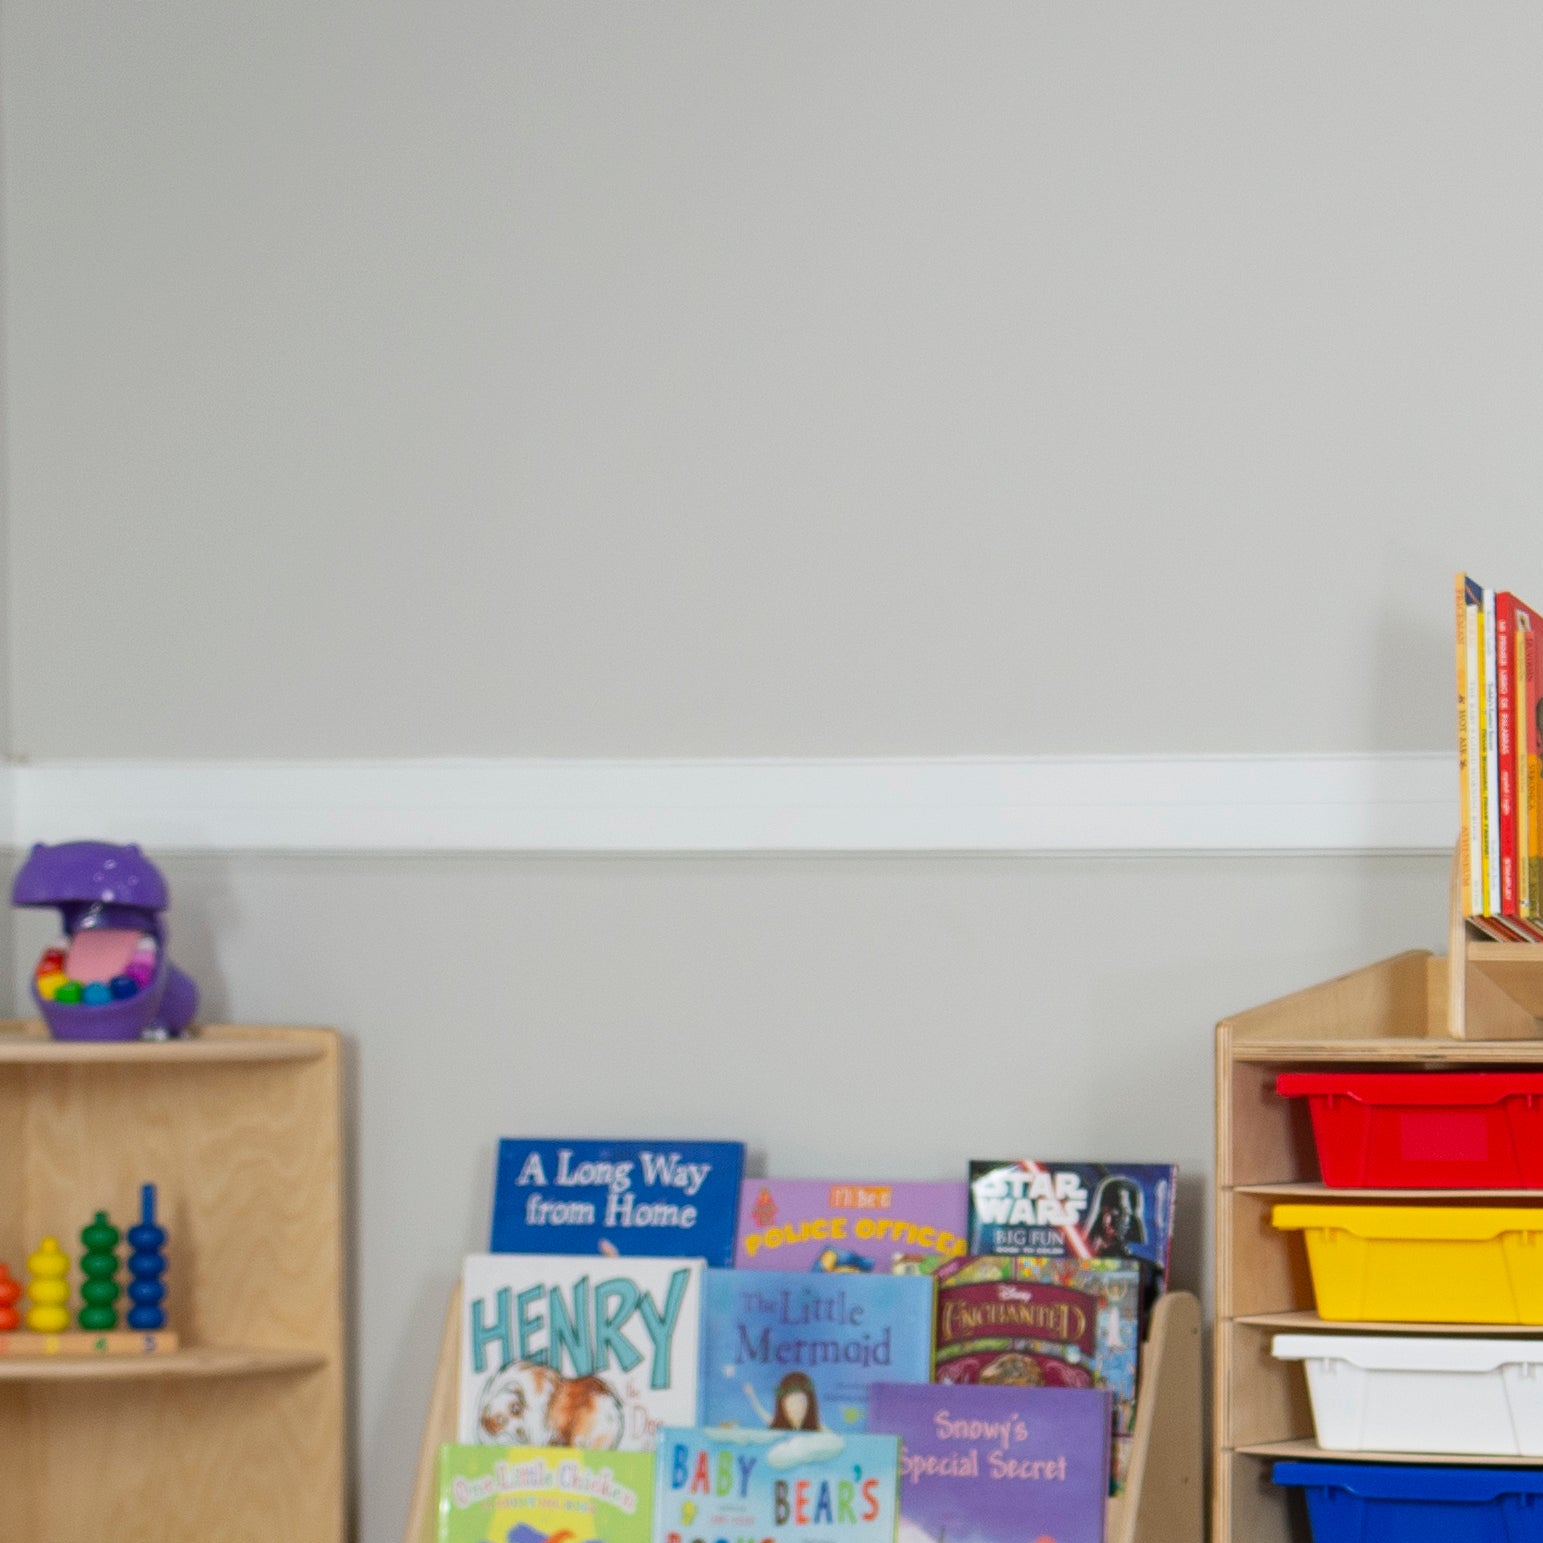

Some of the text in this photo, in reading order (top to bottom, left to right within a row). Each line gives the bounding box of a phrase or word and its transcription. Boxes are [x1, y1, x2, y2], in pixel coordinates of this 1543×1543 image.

[515, 1149, 712, 1196] A Long Way
[525, 1192, 698, 1229] from Home
[976, 1170, 1088, 1226] STAR WARS
[744, 1217, 848, 1257] POLICE
[995, 1229, 1065, 1245] BIG FUN
[779, 1288, 865, 1325] Little
[471, 1267, 692, 1391] HENRY
[735, 1323, 892, 1367] Mermaid
[934, 1408, 1029, 1450] Snowy's
[671, 1444, 880, 1527] BABY BEAR'S
[987, 1450, 1067, 1481] Secret
